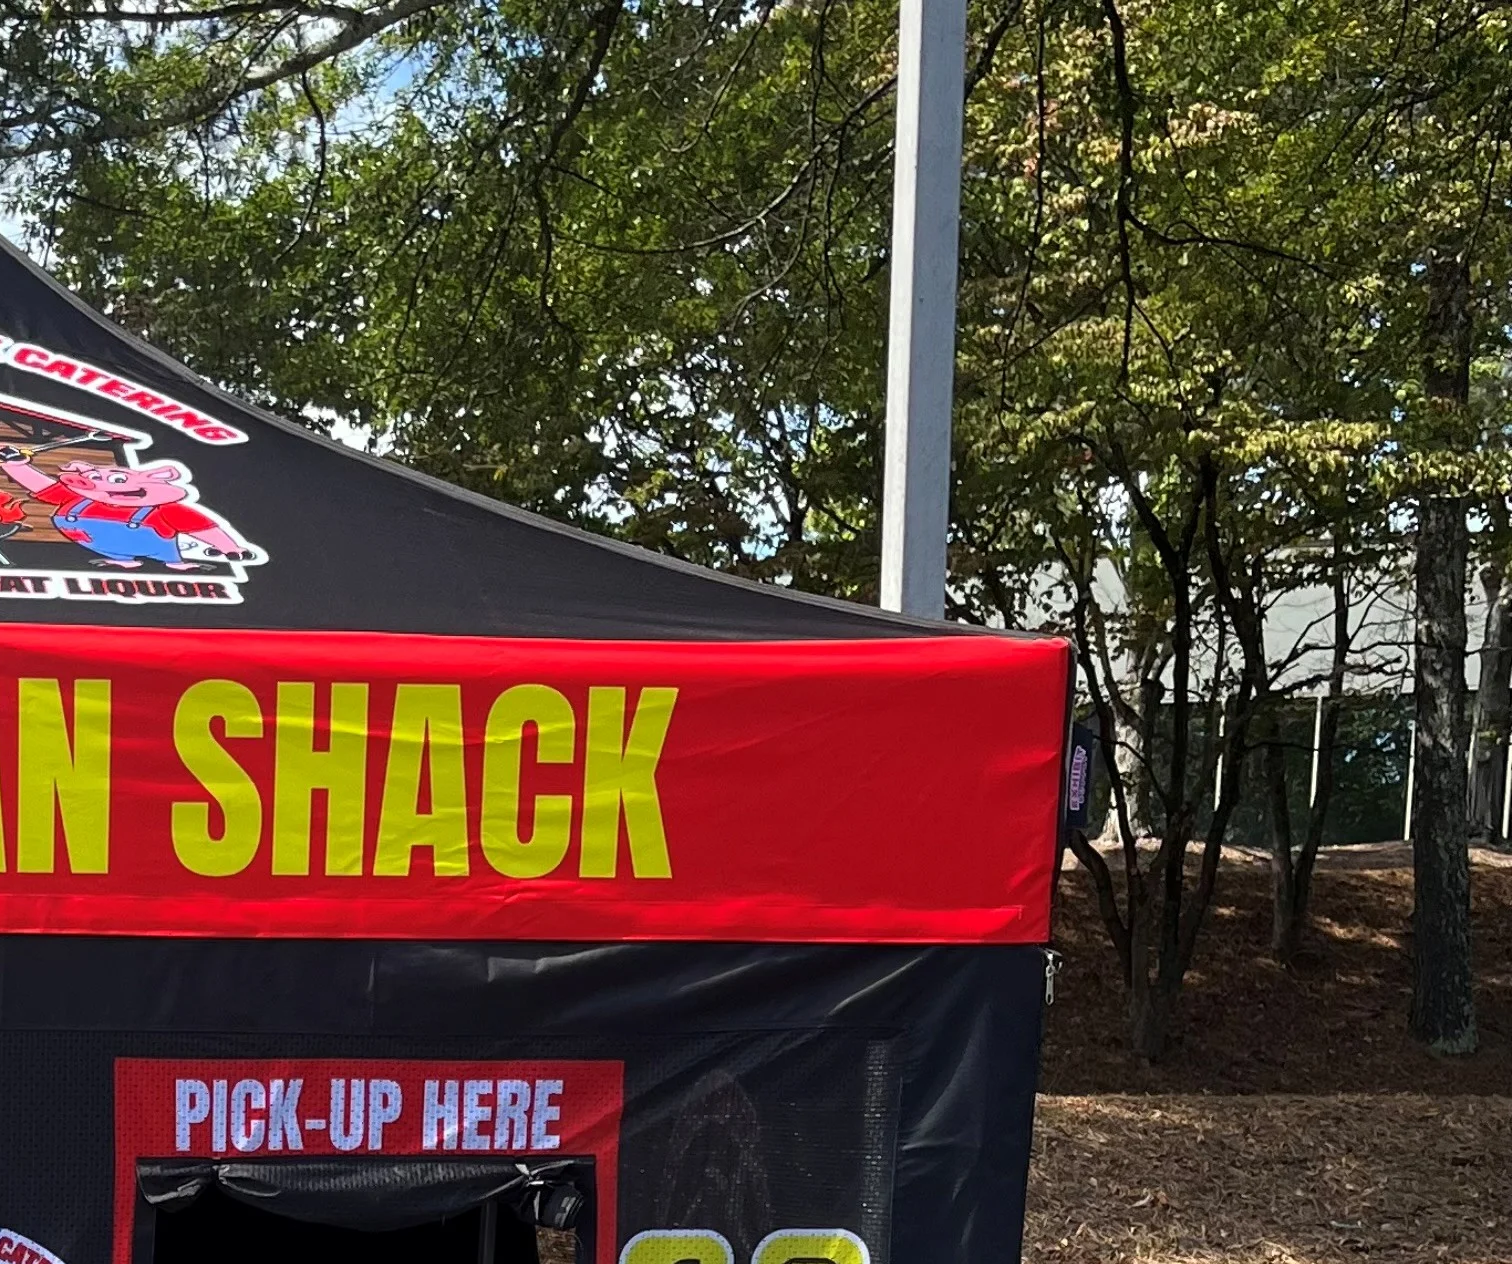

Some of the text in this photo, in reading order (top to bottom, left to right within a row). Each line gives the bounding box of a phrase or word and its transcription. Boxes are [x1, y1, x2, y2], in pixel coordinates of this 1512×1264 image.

[11, 346, 240, 443] CATERING
[62, 576, 232, 600] LIQUOR
[170, 679, 679, 879] SHACK
[174, 1077, 564, 1153] PICK-UP HERE
